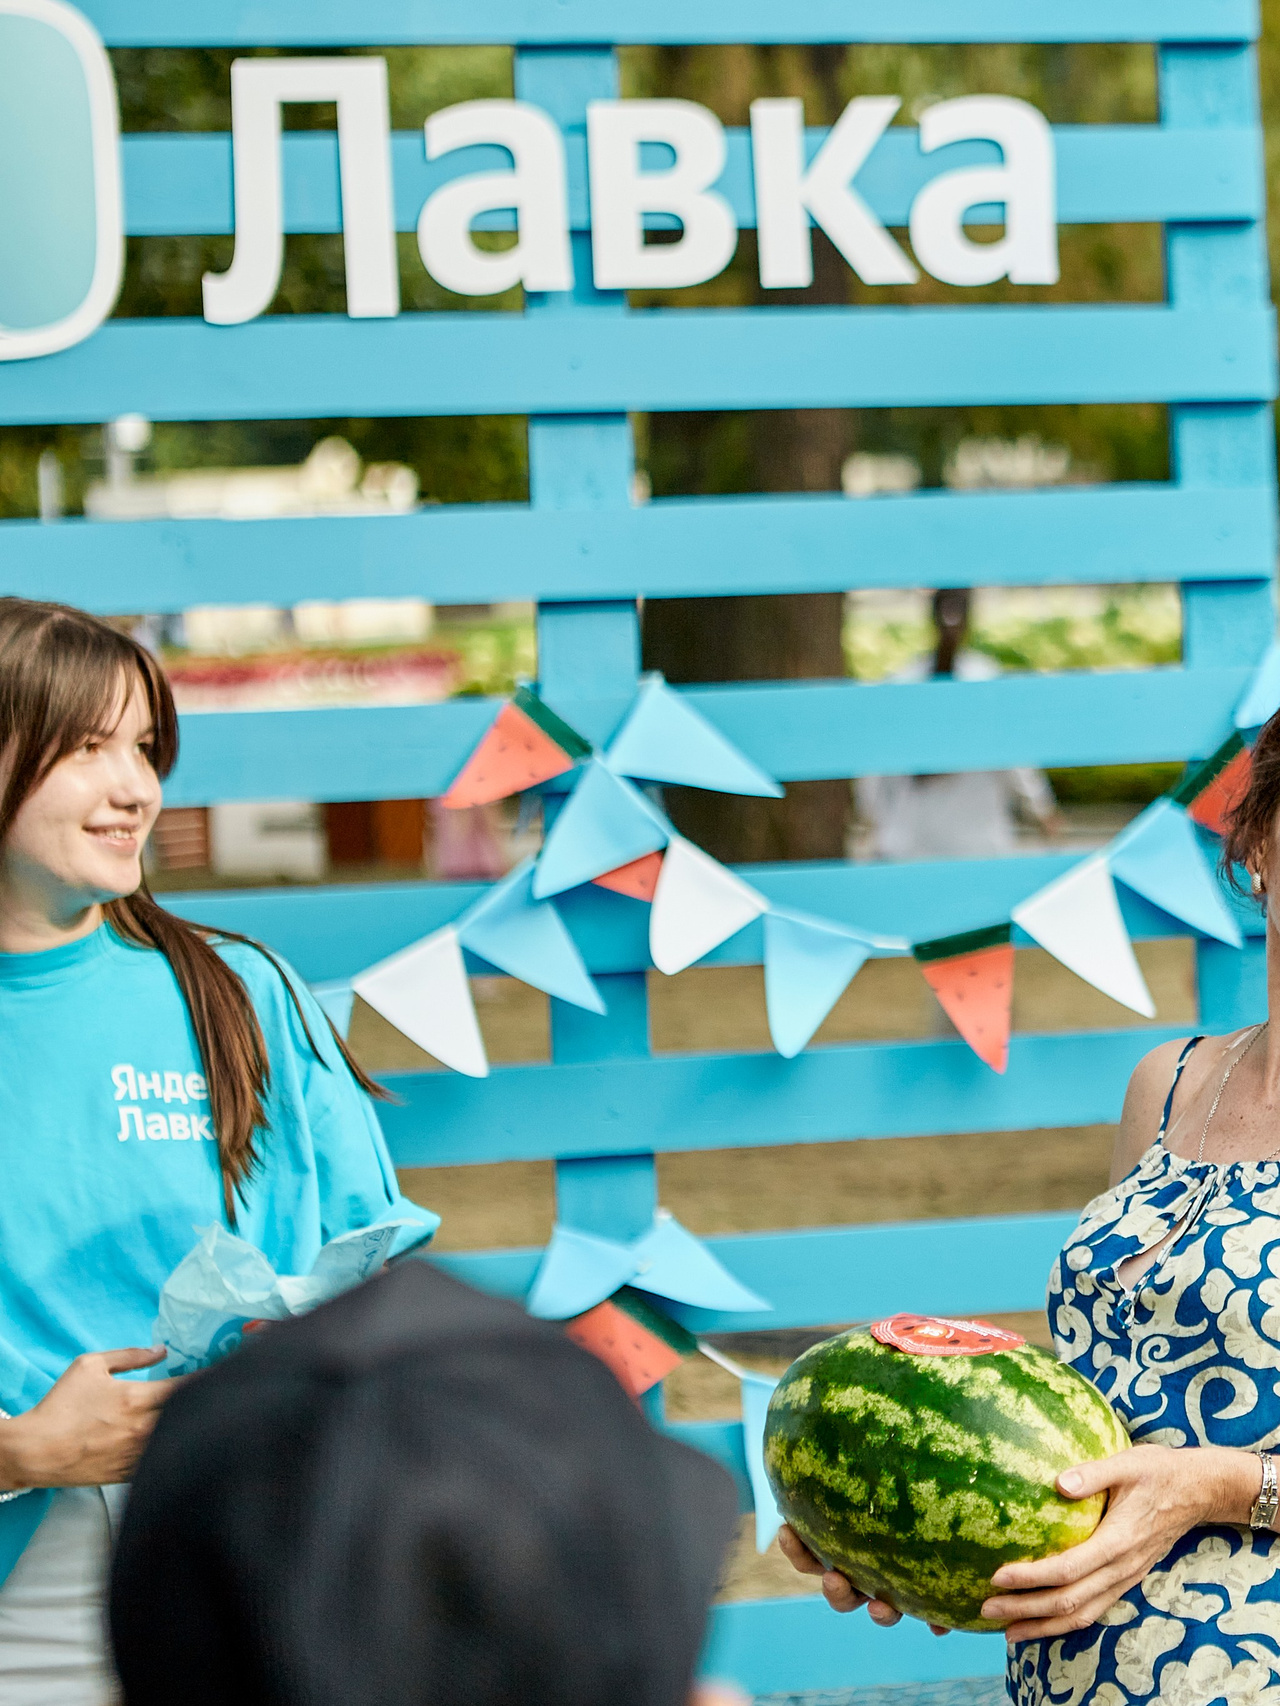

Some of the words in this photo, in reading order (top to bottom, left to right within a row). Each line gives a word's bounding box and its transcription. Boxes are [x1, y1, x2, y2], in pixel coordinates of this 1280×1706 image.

[201, 55, 1060, 326] Лавка
[111, 1064, 208, 1104] Янде
[117, 1105, 217, 1142] Лавк
